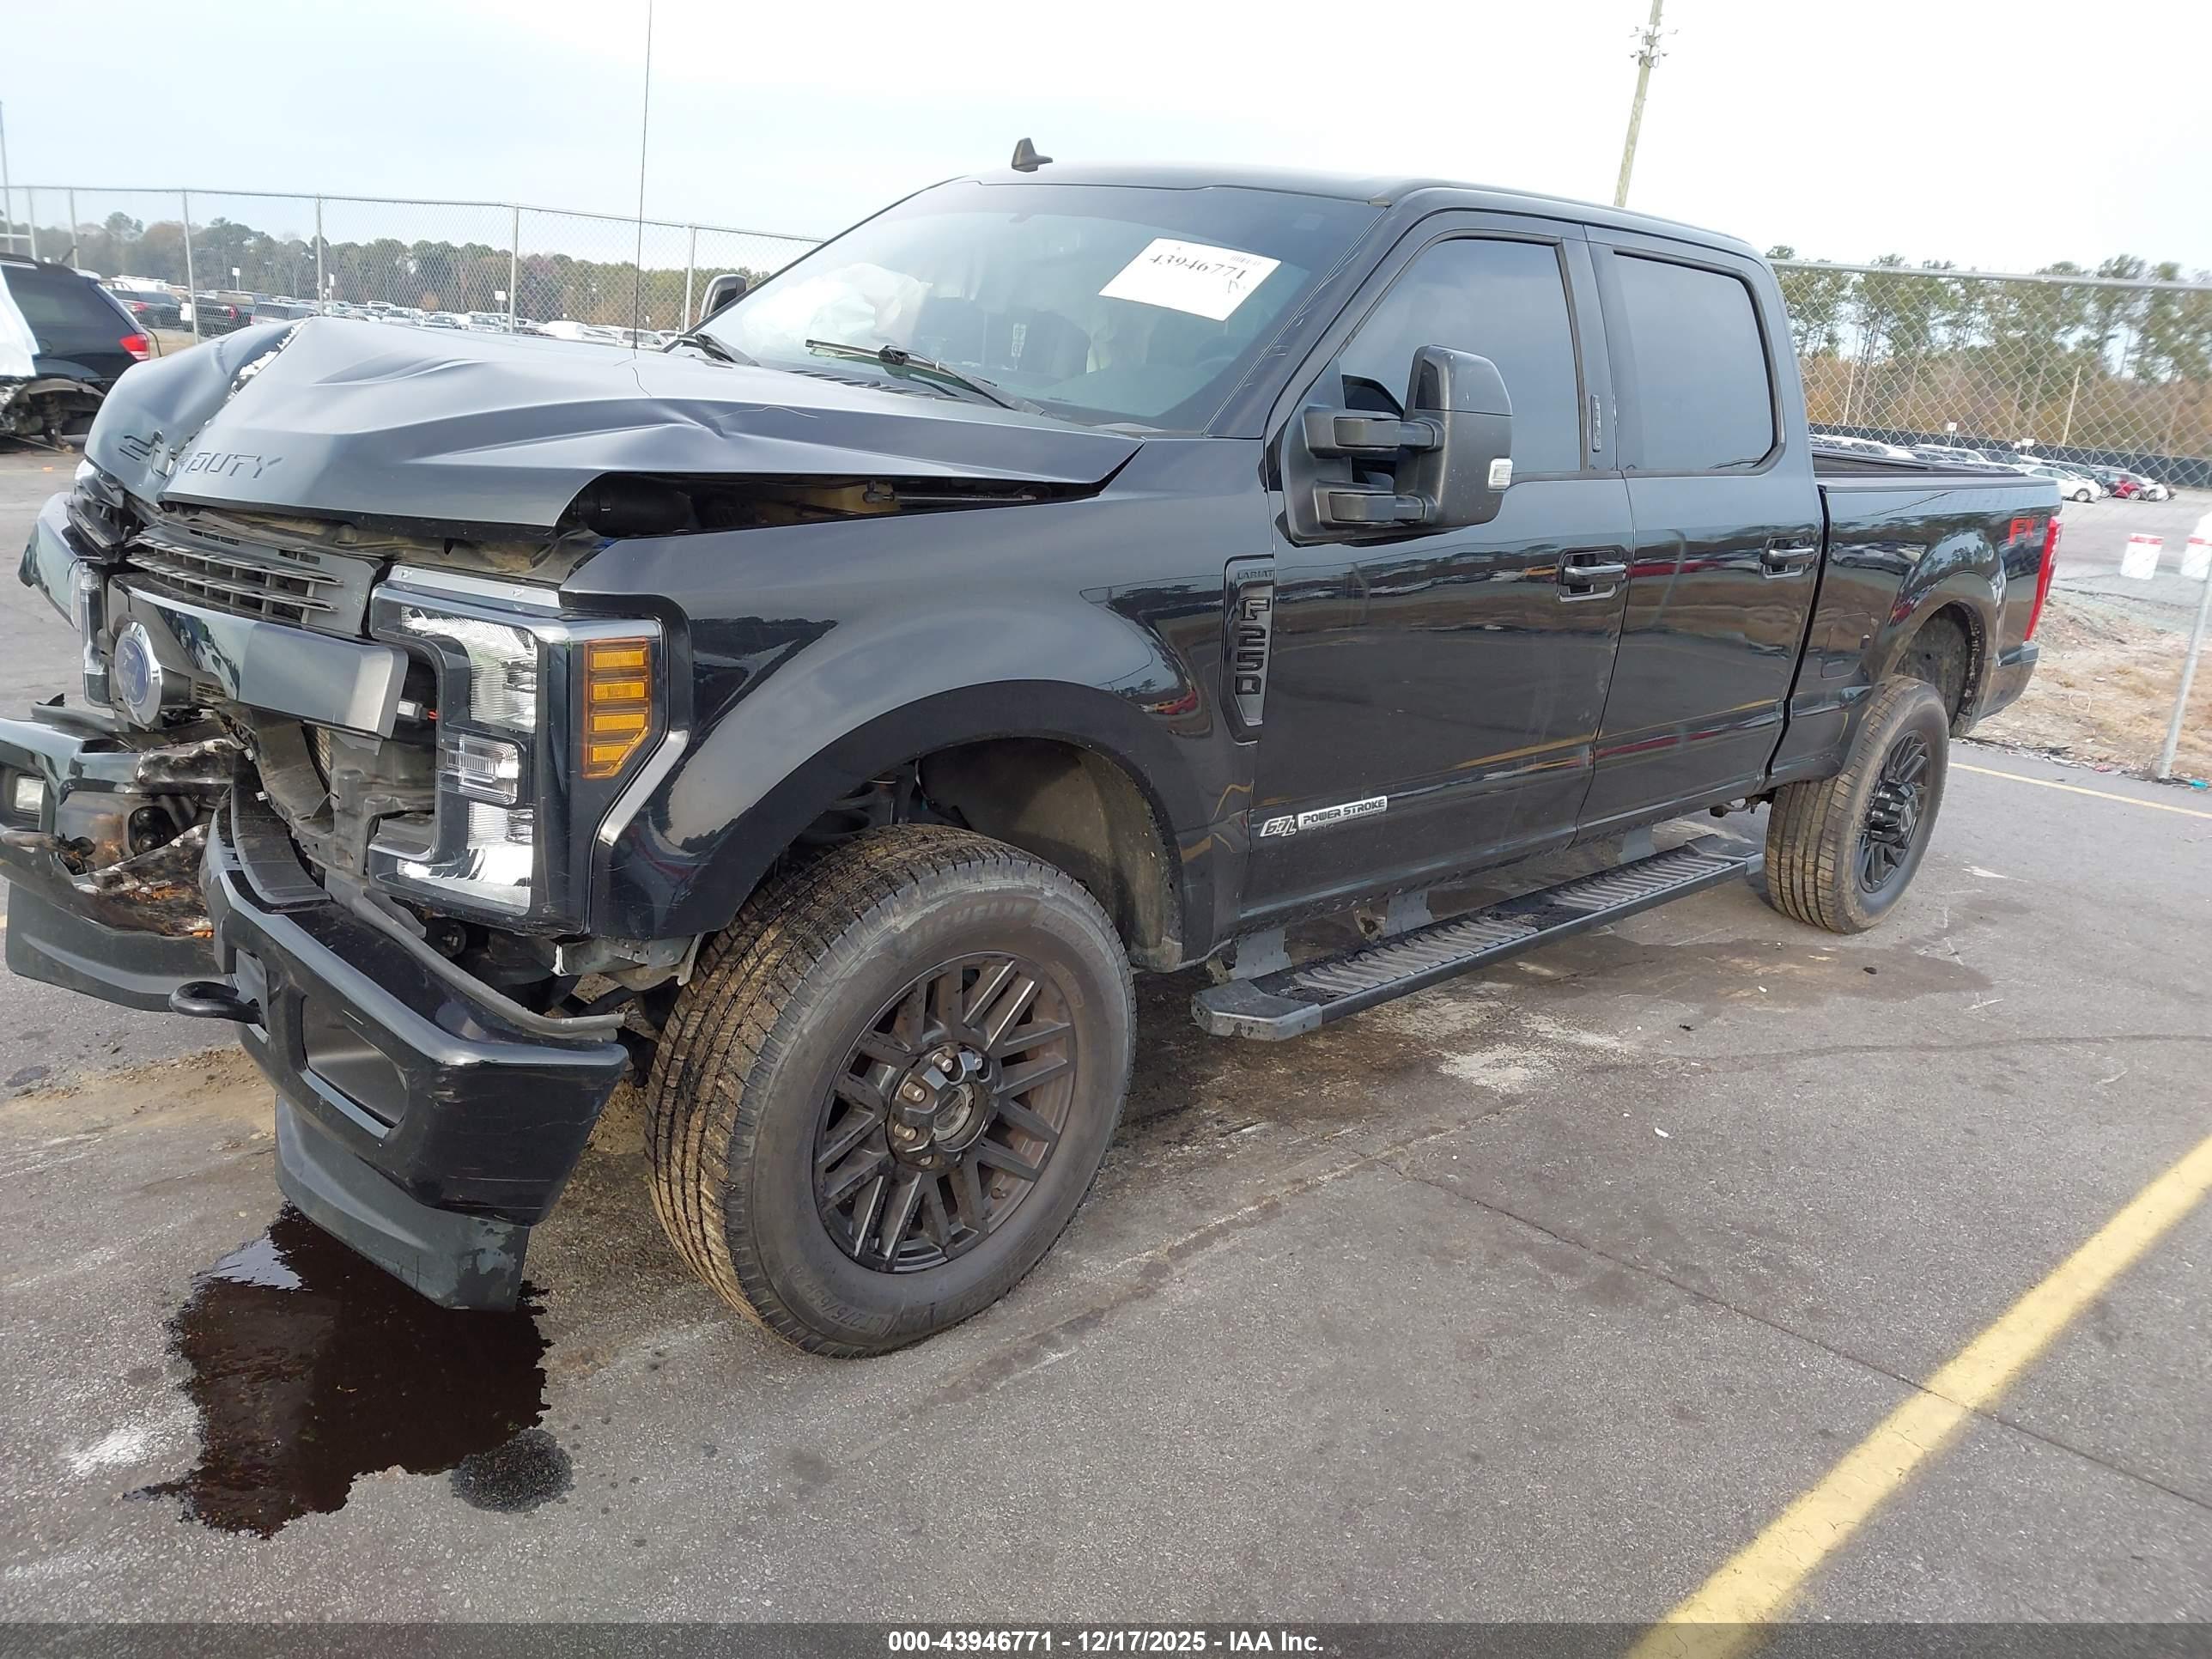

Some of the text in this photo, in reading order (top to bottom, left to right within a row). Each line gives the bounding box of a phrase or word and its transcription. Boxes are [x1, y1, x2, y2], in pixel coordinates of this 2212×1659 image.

[1148, 253, 1248, 280] 43946771
[185, 452, 284, 480] DUTY
[1237, 568, 1274, 580] LARIAT
[1235, 596, 1271, 696] F250
[1303, 809, 1342, 825] POWER
[1343, 799, 1385, 816] STROKE
